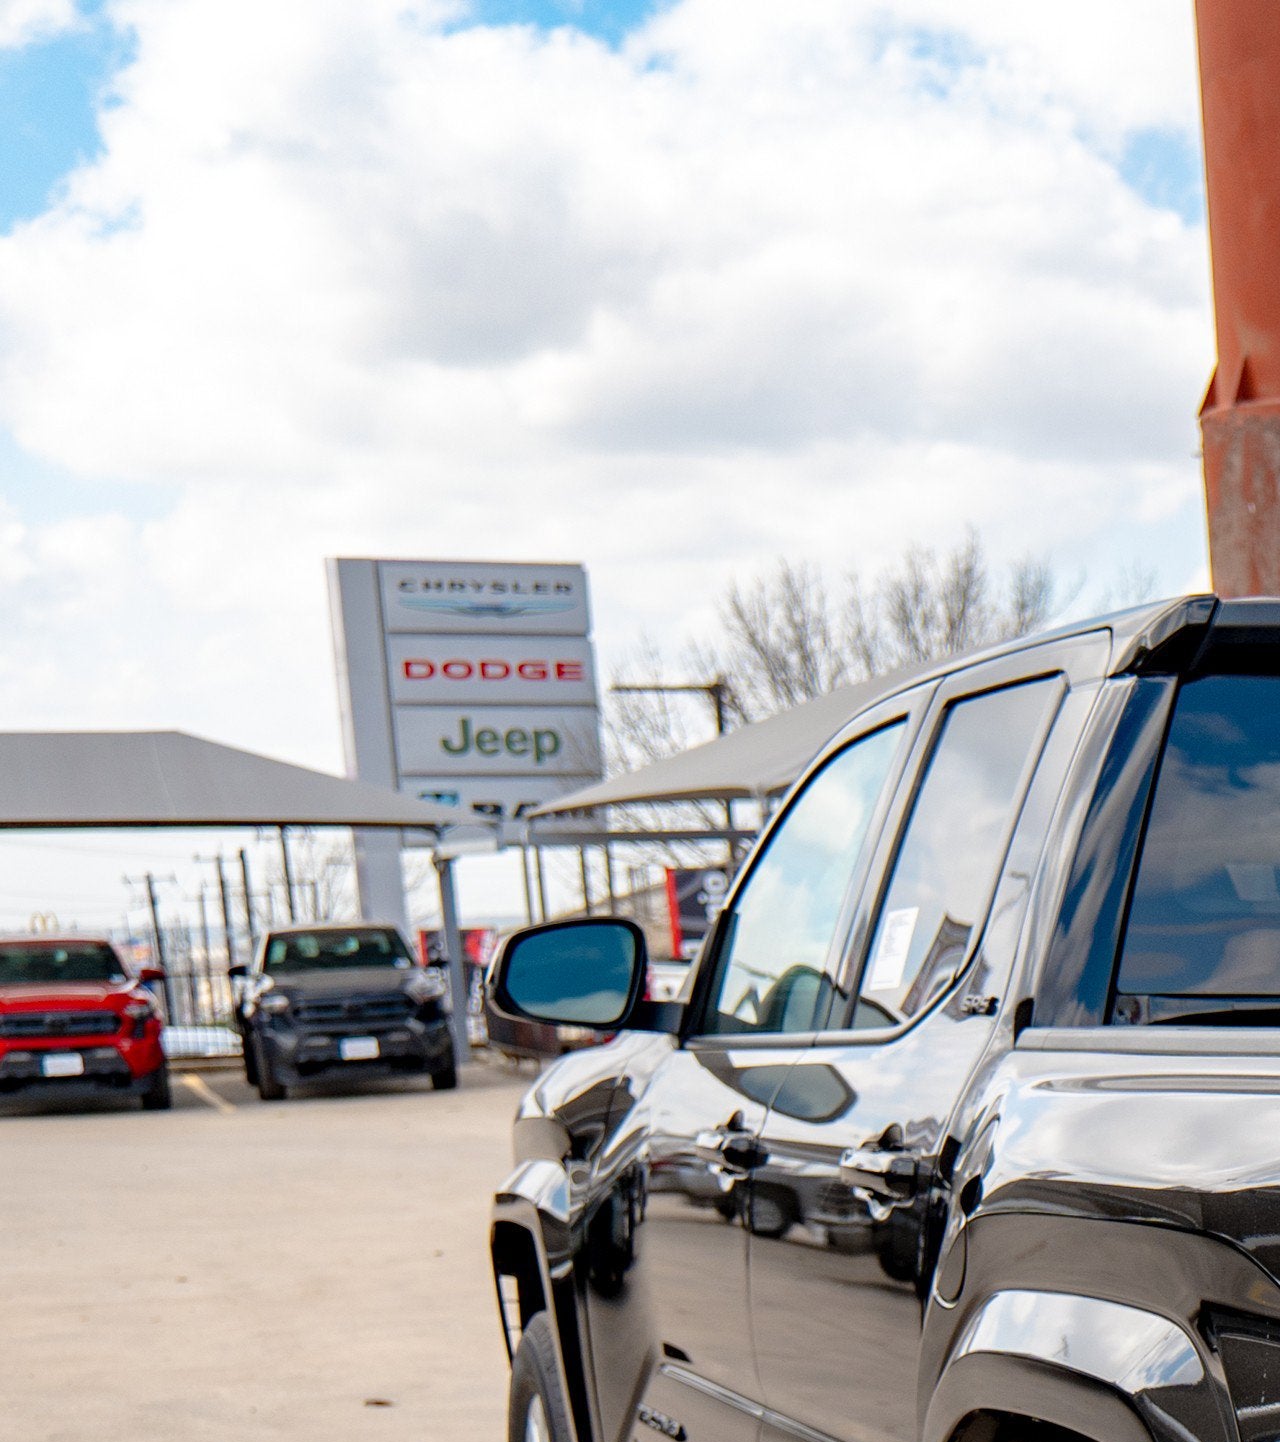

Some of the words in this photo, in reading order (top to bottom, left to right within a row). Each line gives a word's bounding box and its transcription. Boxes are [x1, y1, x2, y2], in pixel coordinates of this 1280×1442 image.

[398, 578, 574, 595] CHRYSLER
[402, 658, 585, 681] DODGE
[440, 716, 561, 764] Jeep
